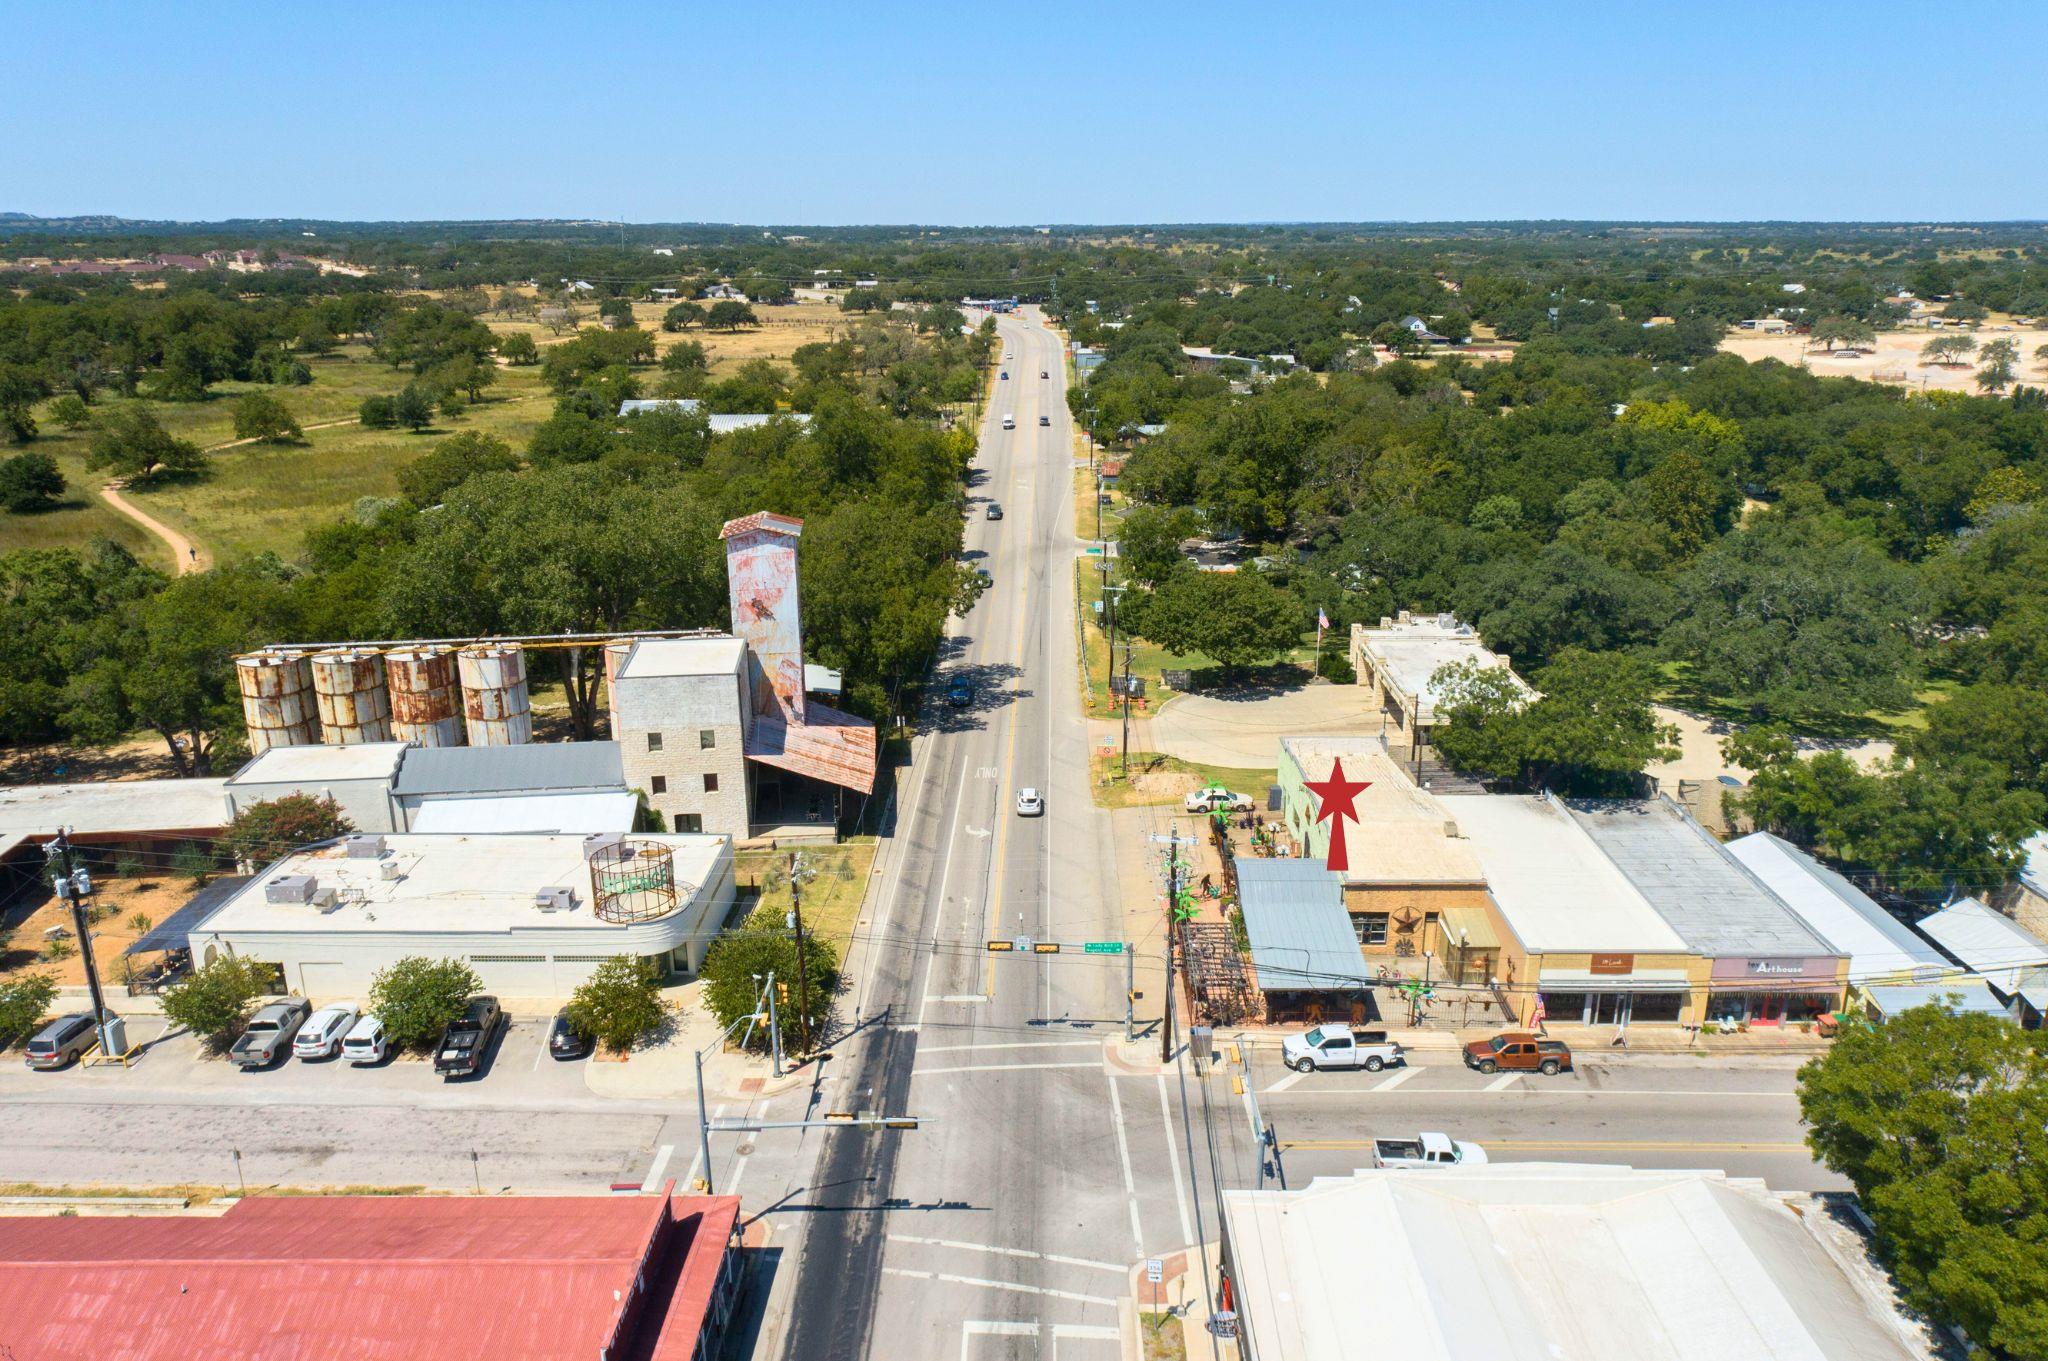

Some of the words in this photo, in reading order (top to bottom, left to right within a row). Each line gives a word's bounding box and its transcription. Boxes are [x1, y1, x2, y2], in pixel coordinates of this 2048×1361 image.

[974, 767, 998, 778] ONLY
[603, 868, 668, 894] SCIENCE
[1756, 961, 1803, 973] Arthouse
